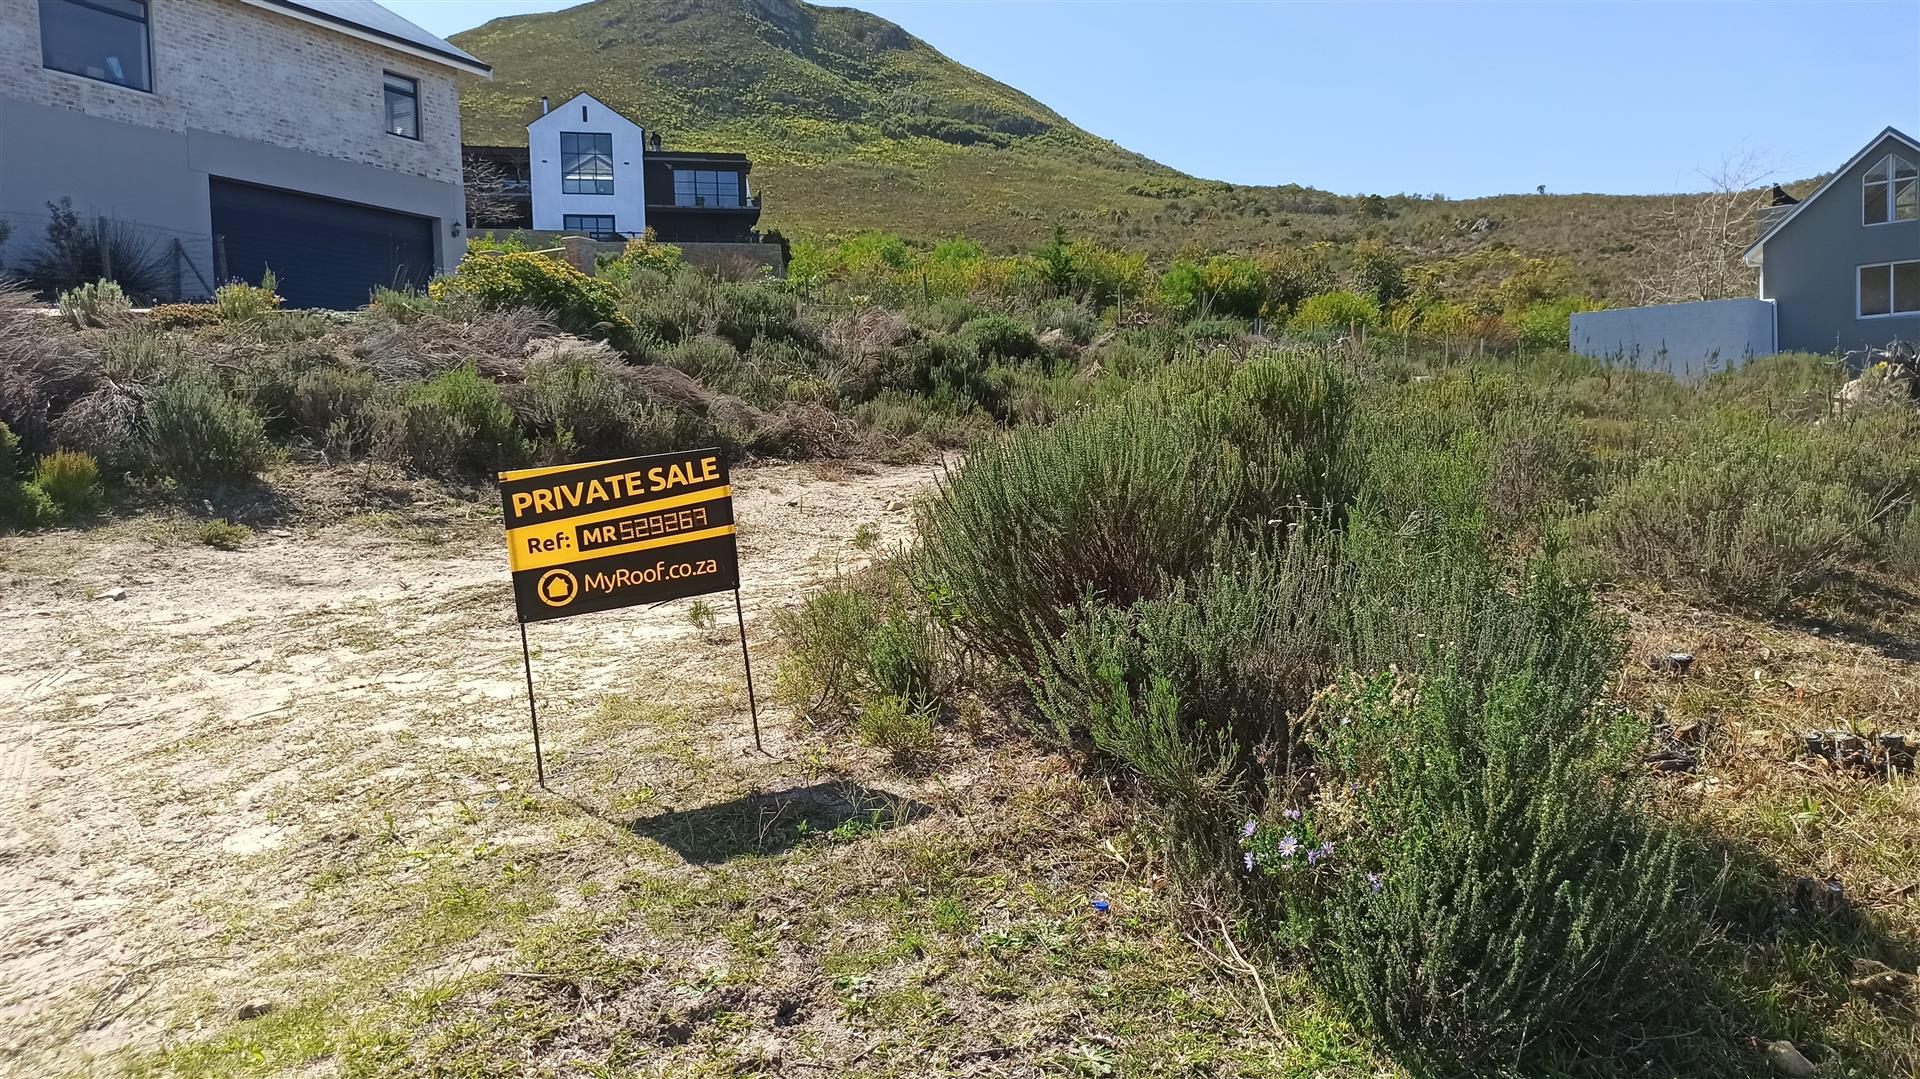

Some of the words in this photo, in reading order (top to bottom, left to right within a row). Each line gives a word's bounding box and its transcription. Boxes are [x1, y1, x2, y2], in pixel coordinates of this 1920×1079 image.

[512, 471, 644, 517] PRIVATE
[648, 456, 720, 492] SALE
[527, 532, 571, 554] Ref:
[584, 559, 717, 594] MyRoof.co.za
